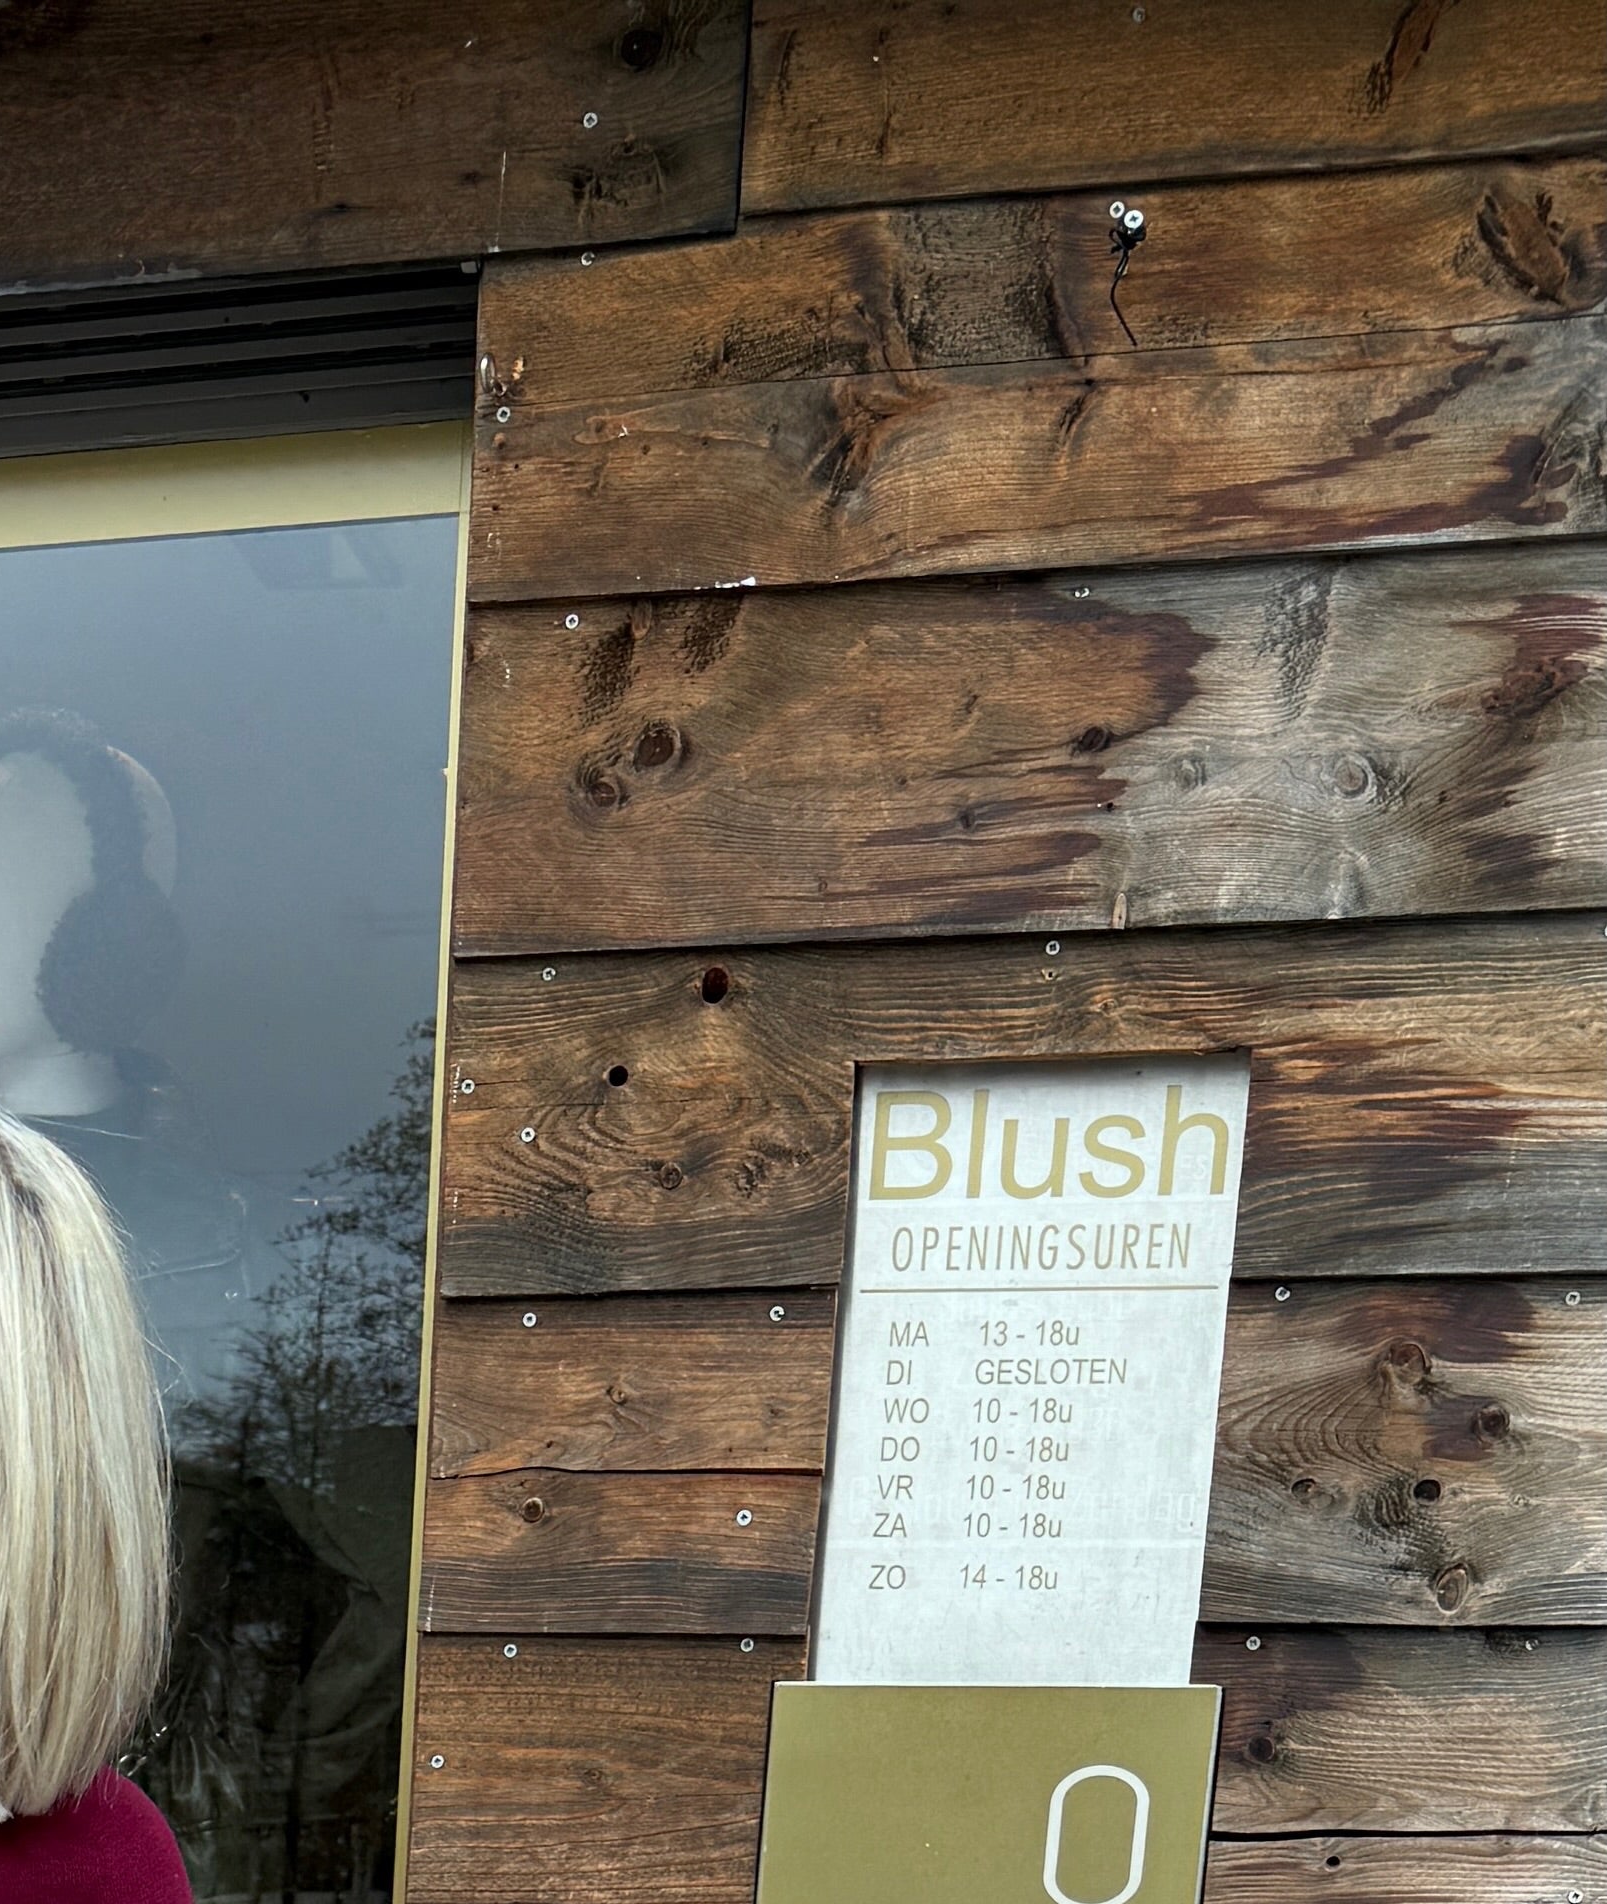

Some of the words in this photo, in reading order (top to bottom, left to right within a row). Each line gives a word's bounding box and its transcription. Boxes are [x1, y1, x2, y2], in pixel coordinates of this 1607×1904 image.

[868, 1084, 1230, 1201] Blush
[892, 1222, 1191, 1272] OPENINGSUREN
[889, 1321, 929, 1347] MA
[980, 1320, 1007, 1347] 13
[1036, 1320, 1080, 1346] 18u
[886, 1360, 912, 1385] DI
[975, 1358, 1128, 1385] GESLOTEN
[884, 1398, 929, 1424] WO
[973, 1398, 1001, 1423] 10
[1029, 1398, 1072, 1423] 18u
[880, 1436, 920, 1462] DO
[970, 1436, 997, 1462] 10
[1026, 1437, 1069, 1463] 18u
[875, 1474, 913, 1500] VR
[967, 1474, 994, 1500] 10
[1022, 1474, 1066, 1500] 18u
[872, 1512, 907, 1538] ZA
[964, 1512, 990, 1537] 10
[1020, 1513, 1062, 1538] 18u
[868, 1565, 906, 1590] ZO
[960, 1564, 986, 1589] 14
[1016, 1565, 1058, 1590] 18u
